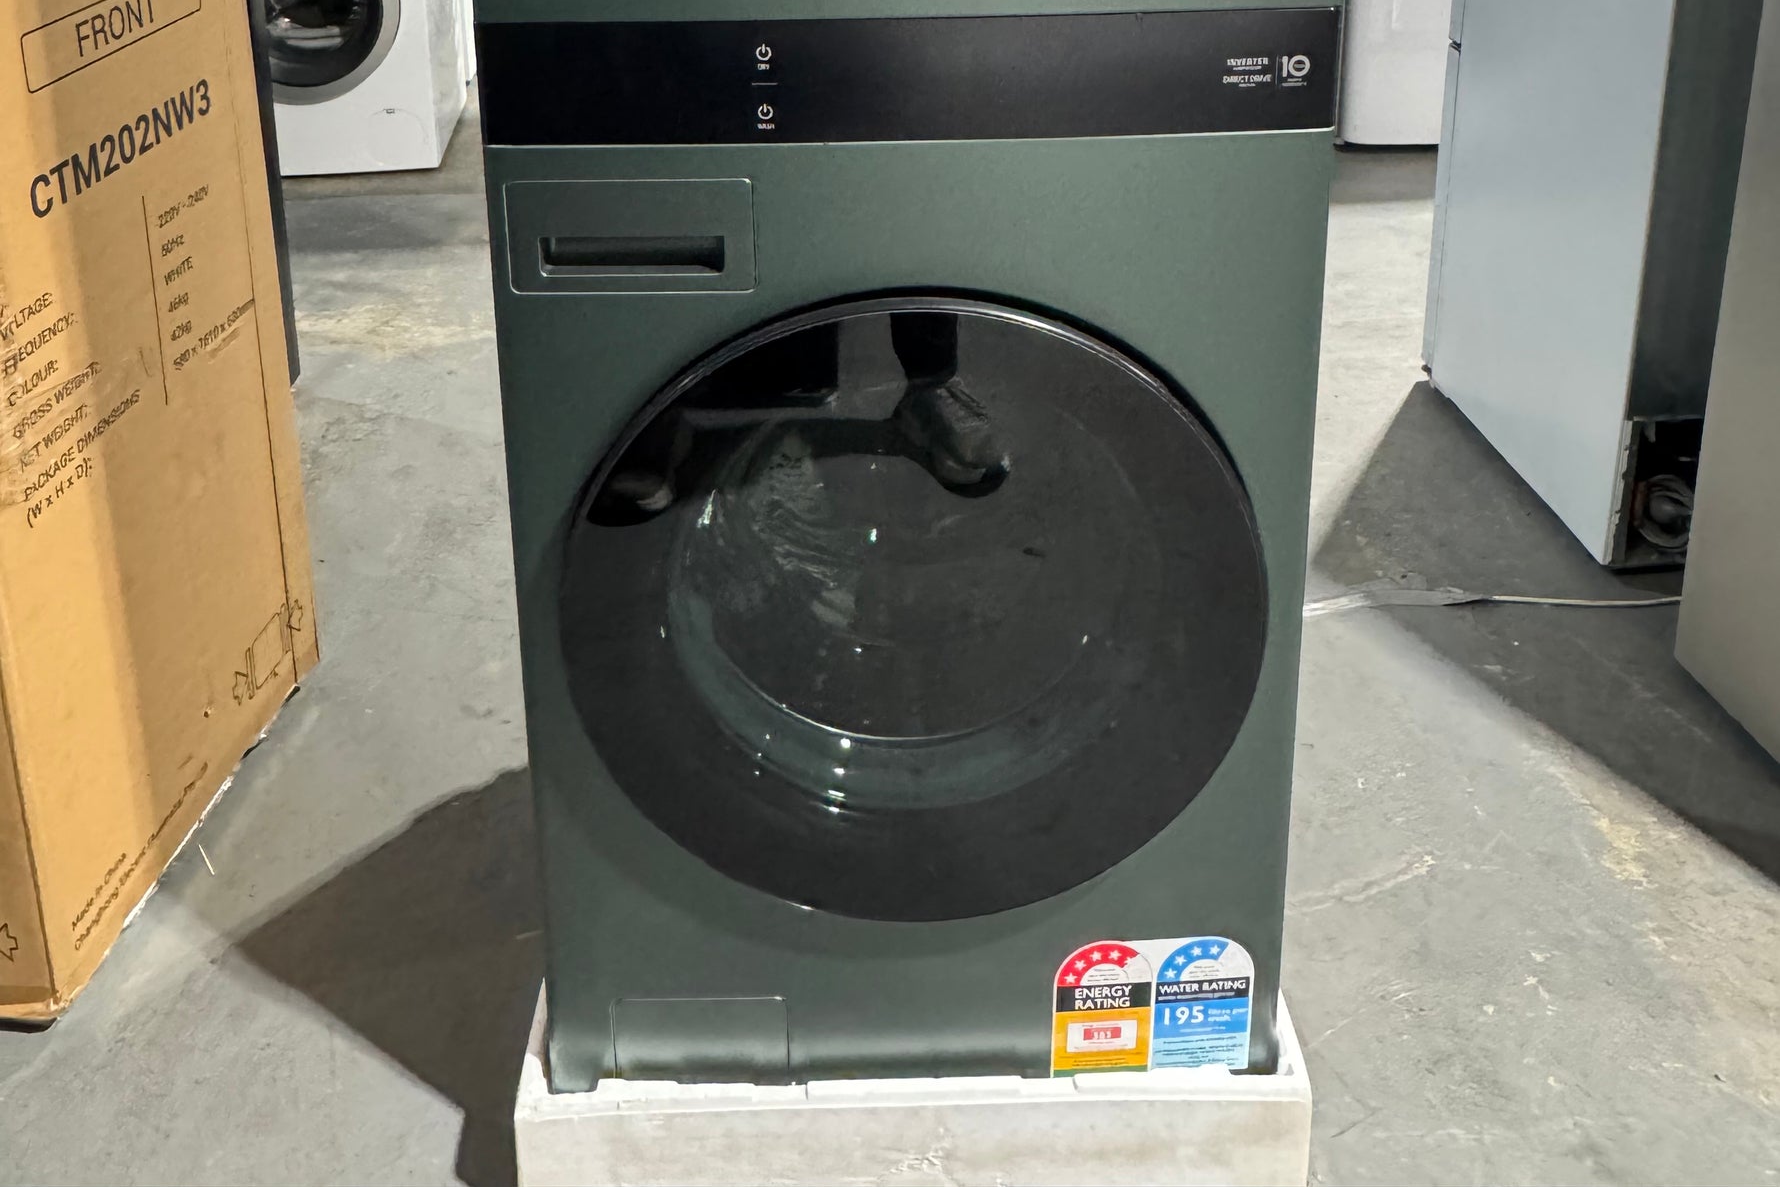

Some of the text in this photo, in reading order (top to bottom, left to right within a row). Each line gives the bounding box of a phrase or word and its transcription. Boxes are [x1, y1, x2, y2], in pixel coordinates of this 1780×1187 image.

[30, 78, 212, 219] CTM202NW3
[1074, 985, 1133, 999] ENERGY
[1159, 979, 1247, 995] WATER RATING
[1074, 996, 1132, 1010] RATING
[1163, 1005, 1206, 1026] 195
